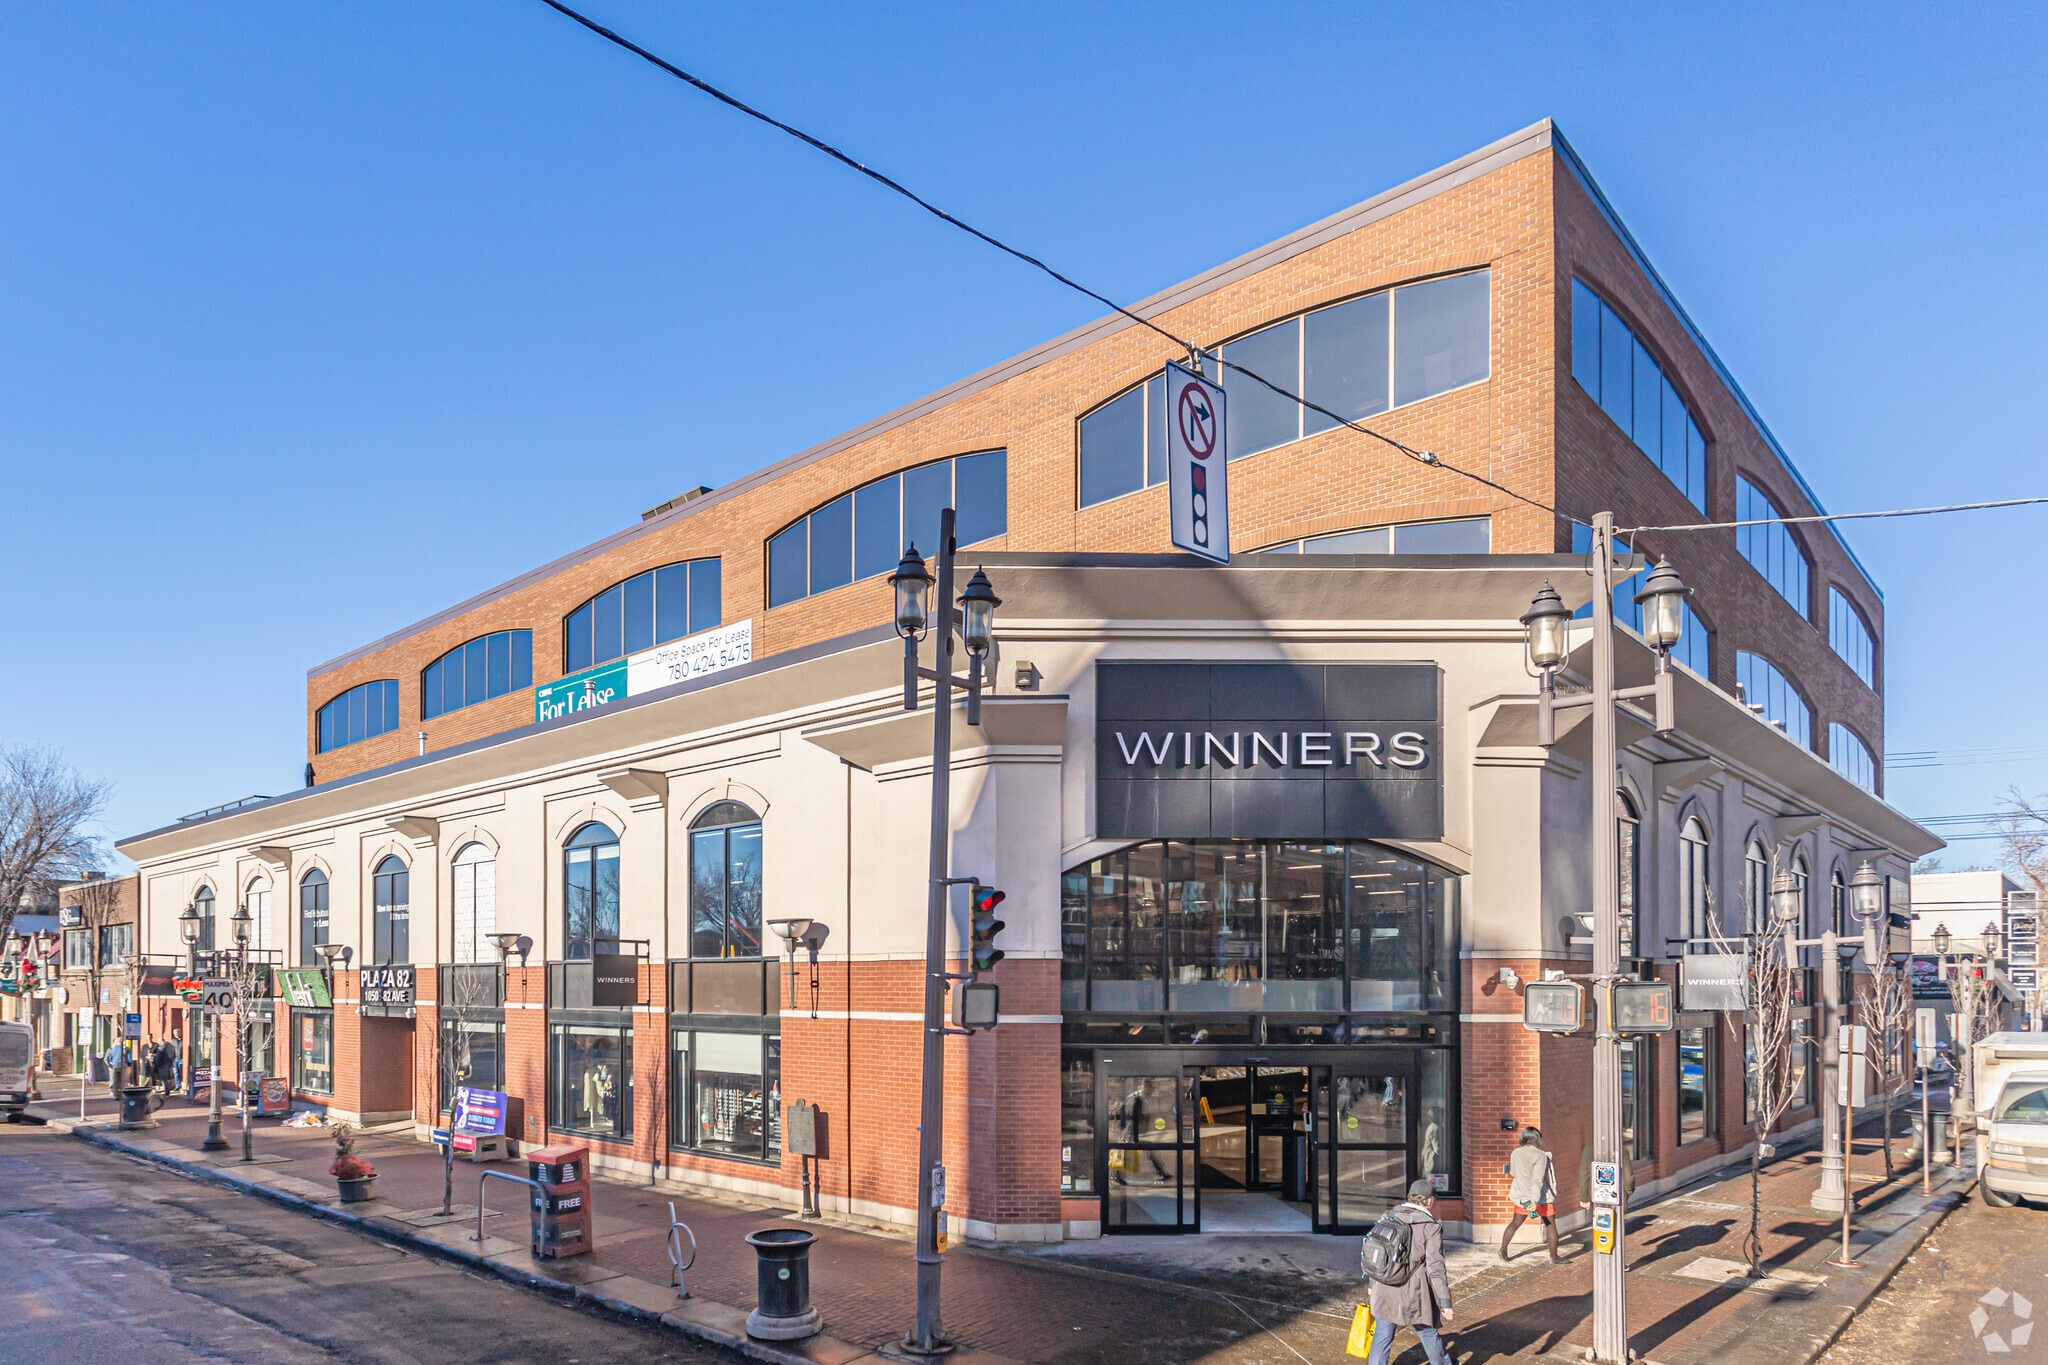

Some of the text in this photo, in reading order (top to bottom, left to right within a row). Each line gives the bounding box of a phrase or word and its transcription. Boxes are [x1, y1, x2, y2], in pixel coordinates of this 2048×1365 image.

[656, 628, 750, 665] Office Space For Lease
[668, 643, 750, 682] 780 424 5475
[539, 699, 566, 722] For
[1115, 731, 1426, 767] WINNERS
[361, 969, 410, 988] PLAZA 82
[596, 976, 635, 984] WINNERS
[1687, 978, 1744, 986] WINNERS
[205, 992, 233, 1008] 40
[391, 990, 406, 1002] AVE
[535, 1197, 582, 1211] FRE FREE
